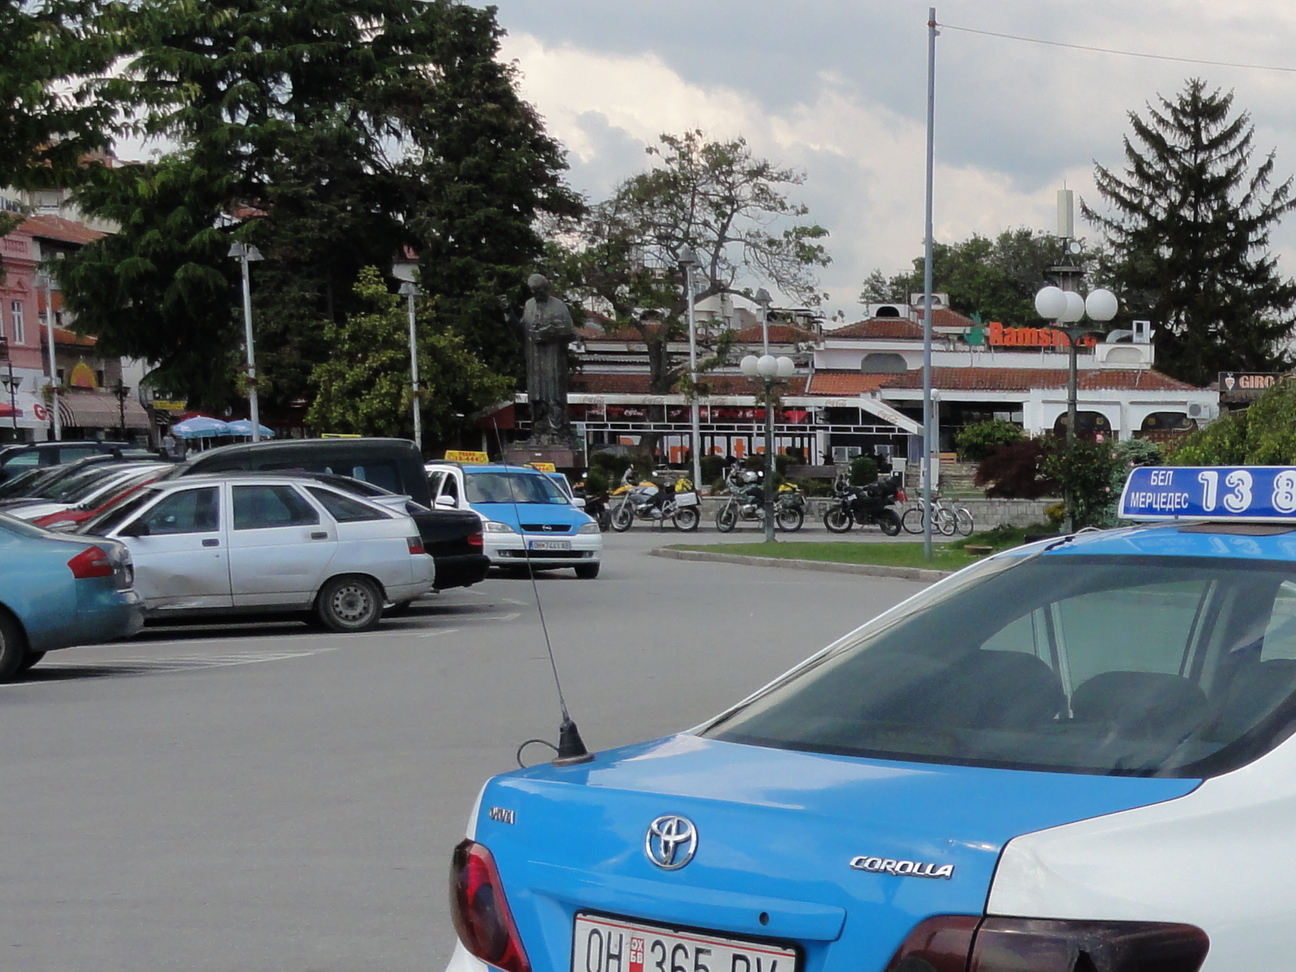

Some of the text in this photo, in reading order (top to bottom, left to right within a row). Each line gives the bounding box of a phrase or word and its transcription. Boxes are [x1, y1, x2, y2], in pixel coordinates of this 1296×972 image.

[1150, 470, 1173, 486] БЕЛ
[1198, 469, 1252, 512] 13
[1130, 492, 1189, 512] МЕРЦЕДЕС
[849, 855, 956, 880] COROLLA
